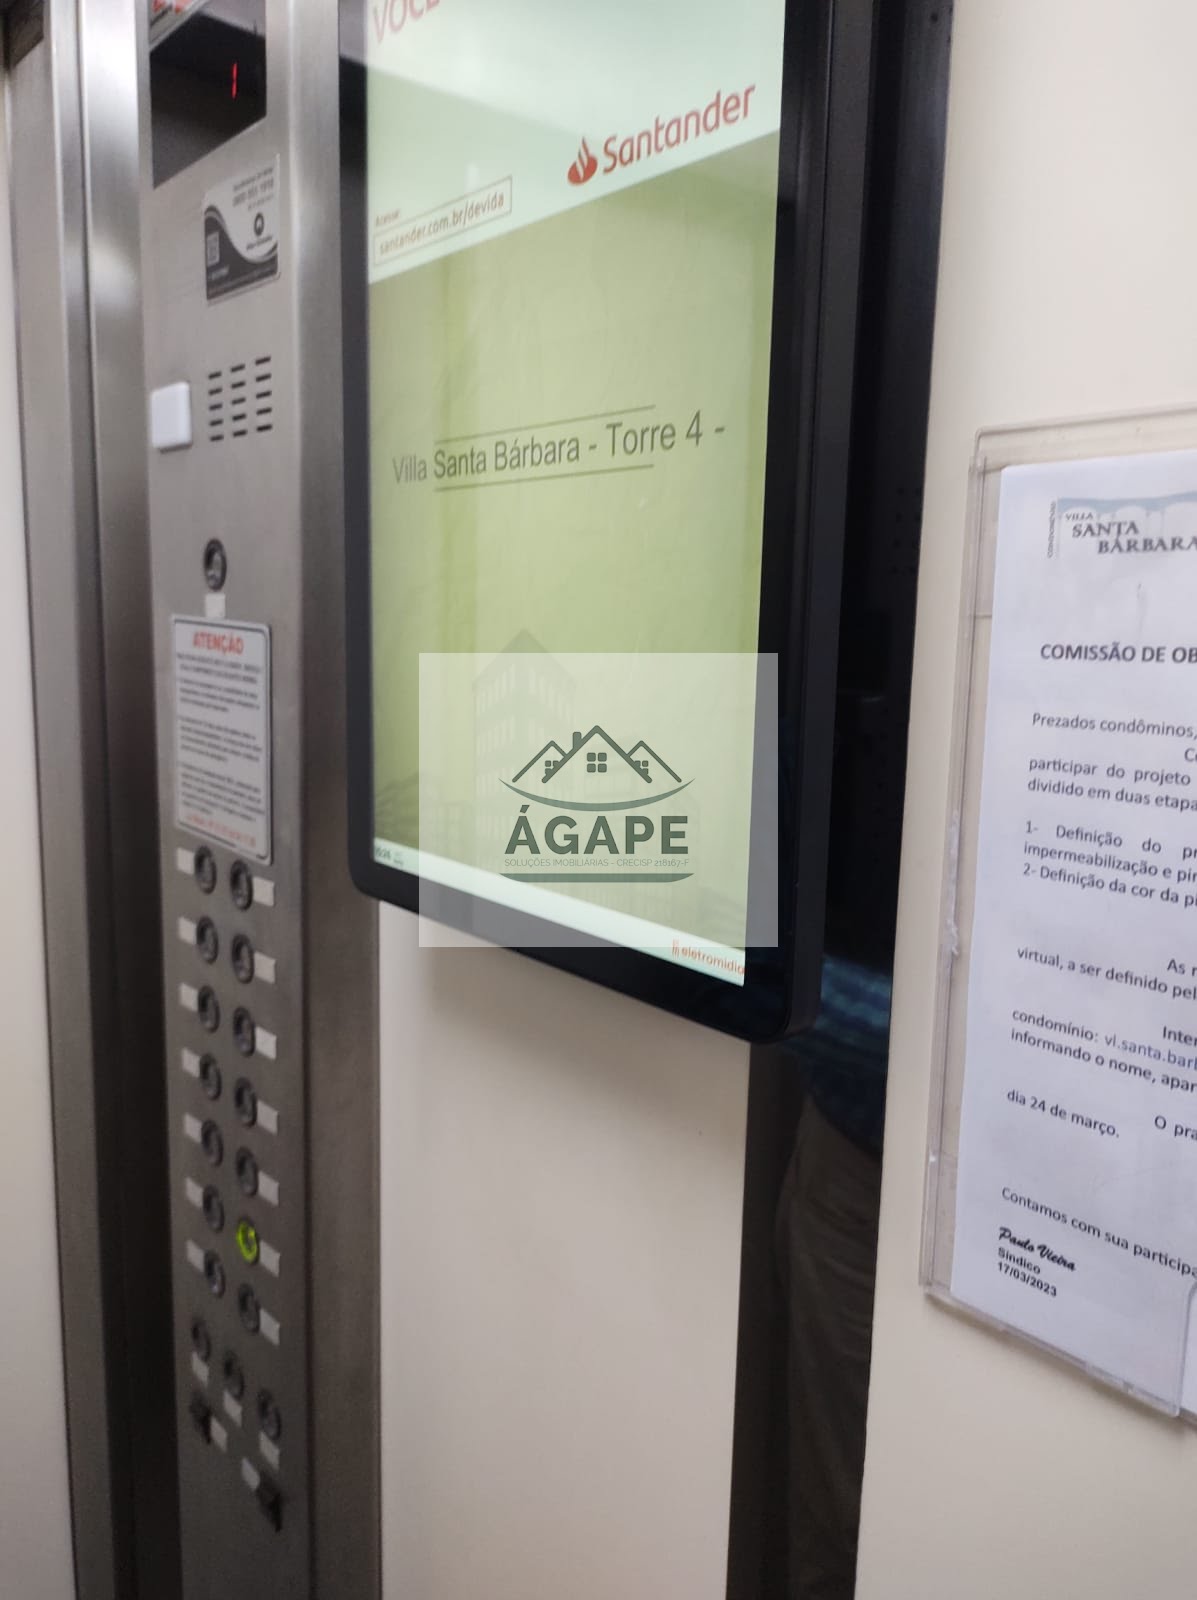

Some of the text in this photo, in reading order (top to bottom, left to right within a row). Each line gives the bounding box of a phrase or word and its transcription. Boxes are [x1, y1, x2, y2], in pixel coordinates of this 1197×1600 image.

[603, 84, 756, 175] Santander
[379, 191, 505, 255] santander.com.br/devida
[392, 454, 428, 484] Villa
[433, 448, 488, 479] Santa
[494, 436, 580, 472] Bárbara
[606, 421, 676, 457] Torre
[686, 409, 703, 446] 4
[1065, 512, 1094, 521] VILLA
[1071, 521, 1139, 538] SANTA
[1040, 641, 1136, 662] COMISSÃO
[1141, 646, 1166, 663] DE
[1032, 712, 1197, 740] Prezados condôminos,
[1027, 777, 1084, 797] dividido
[1088, 787, 1111, 800] em
[1115, 788, 1151, 805] duas
[1029, 758, 1191, 787] participar do projeto
[1025, 820, 1039, 834] 1-
[1055, 824, 1123, 848] Definição
[1141, 837, 1162, 853] do
[1024, 840, 1158, 877] impermeabilização
[1162, 866, 1172, 879] e
[1022, 862, 1037, 876] 2-
[1040, 865, 1104, 889] Definição
[1109, 878, 1126, 894] da
[1131, 884, 1155, 899] cor
[1160, 887, 1179, 904] da
[1017, 947, 1064, 971] virtual,
[1067, 960, 1076, 971] a
[1079, 963, 1101, 977] ser
[1105, 967, 1168, 994] definido
[1166, 958, 1186, 976] As
[1012, 1009, 1099, 1043] condomínio:
[1011, 1028, 1091, 1063] informando
[1095, 1053, 1105, 1066] o
[1108, 1056, 1157, 1083] nome,
[1006, 1088, 1120, 1139] dia 24 de março.
[1154, 1114, 1167, 1130] O
[1001, 1186, 1068, 1225] Contamos
[1071, 1217, 1101, 1239] com
[1104, 1231, 1129, 1250] sua
[998, 1226, 1077, 1272] Paulo Vieira
[997, 1261, 1057, 1298] 17/03/2023
